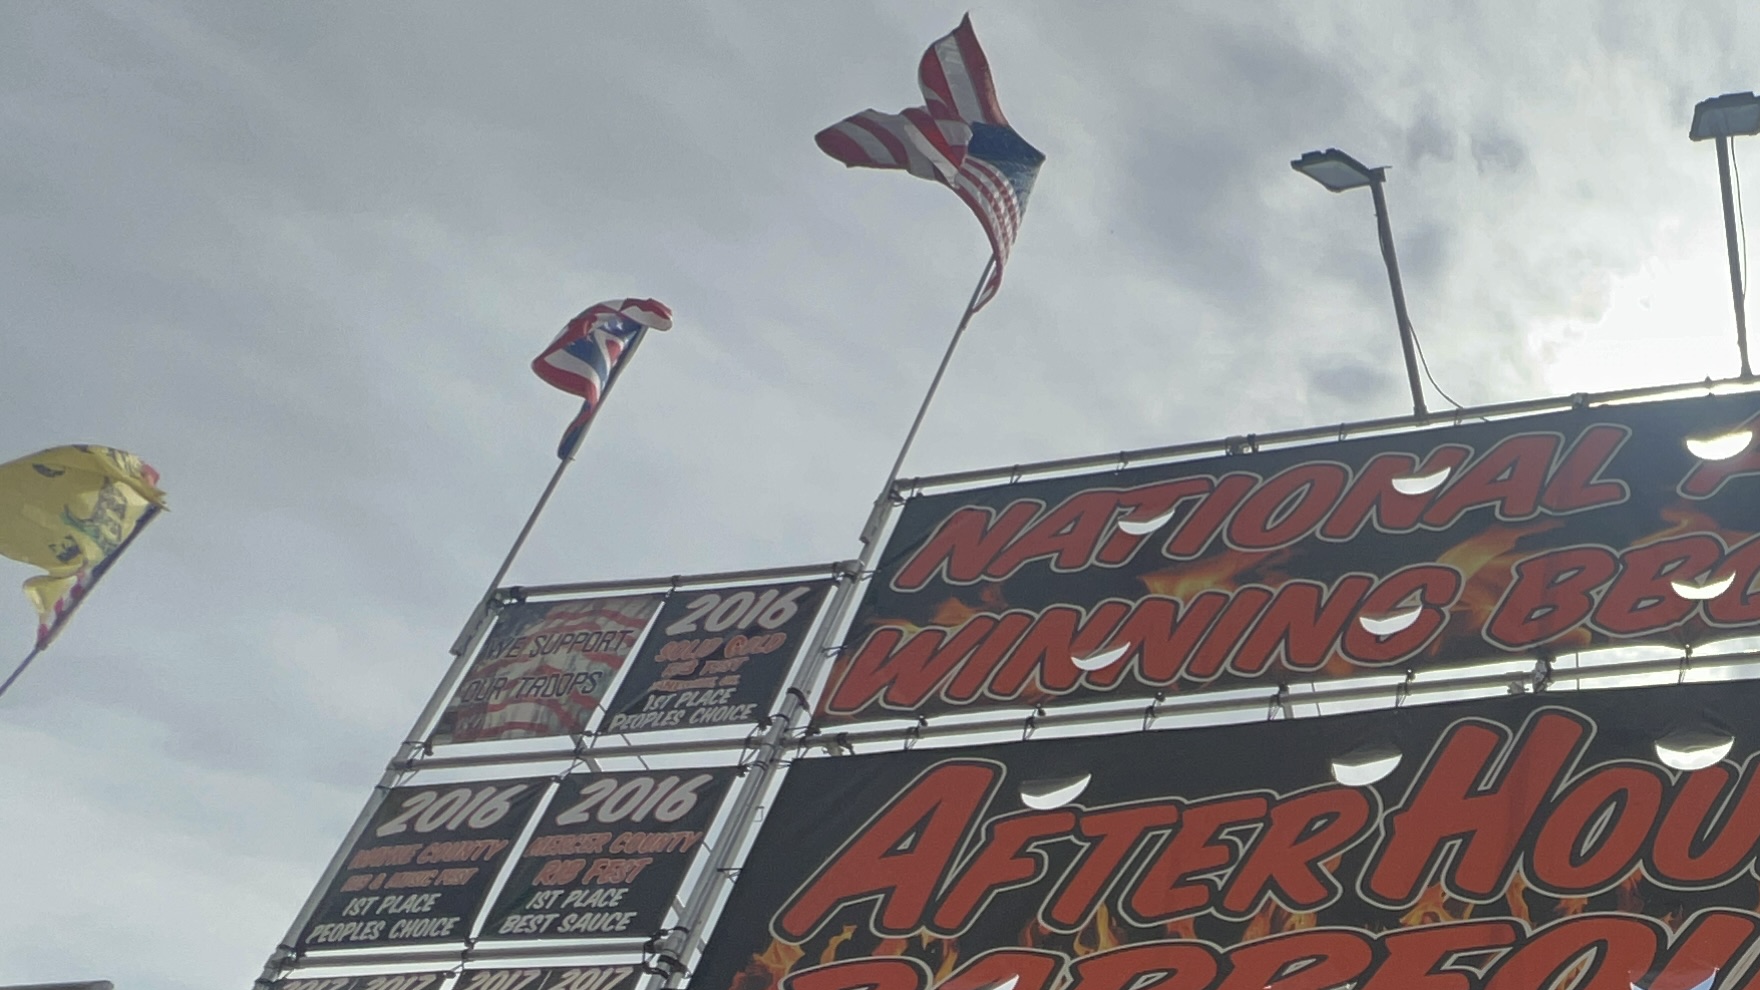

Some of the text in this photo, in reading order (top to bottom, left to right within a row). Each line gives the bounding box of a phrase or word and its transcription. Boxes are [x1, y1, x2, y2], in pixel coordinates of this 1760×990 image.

[891, 424, 1631, 591] NATIONAL
[666, 587, 810, 636] 2016
[528, 630, 633, 657] SUPPORT
[825, 565, 1463, 715] WINNING
[517, 672, 602, 699] TROOPS
[607, 703, 757, 733] PEOPLES CHOICE
[376, 784, 528, 838] 2016
[556, 775, 712, 827] 2016
[770, 758, 1383, 944] AFTER
[307, 917, 460, 944] PEOPLES CHOICE
[500, 912, 637, 935] BEST SAUCE
